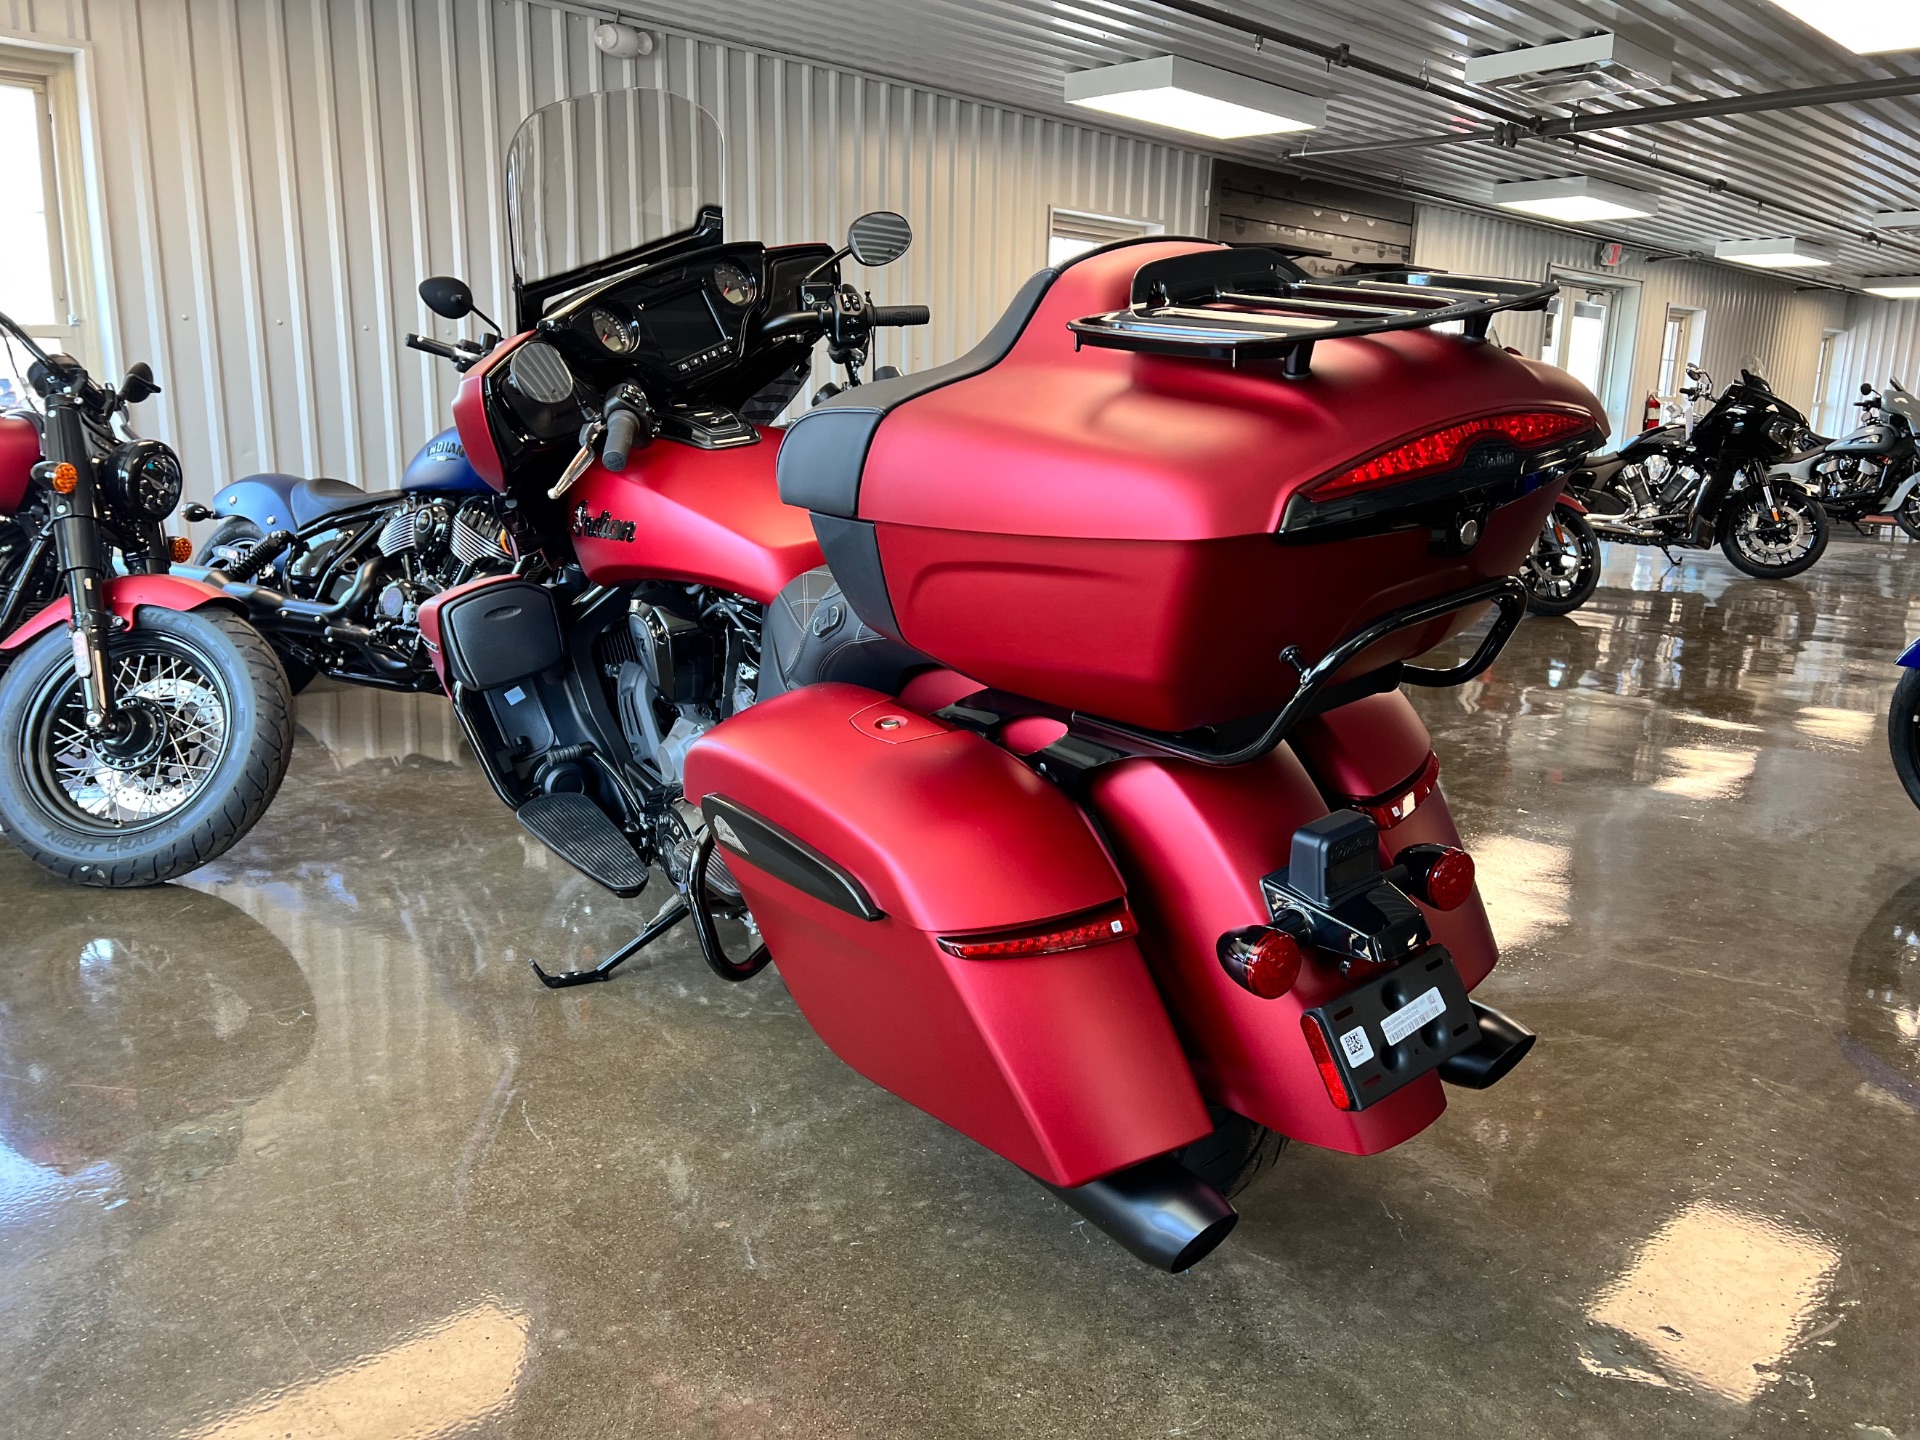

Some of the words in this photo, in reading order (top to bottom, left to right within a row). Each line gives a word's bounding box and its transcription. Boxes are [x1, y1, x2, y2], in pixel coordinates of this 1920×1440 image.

[426, 441, 465, 457] INDIAN
[573, 500, 636, 543] Indian
[44, 830, 100, 852] NIGHT
[106, 819, 183, 852] DRAGON
